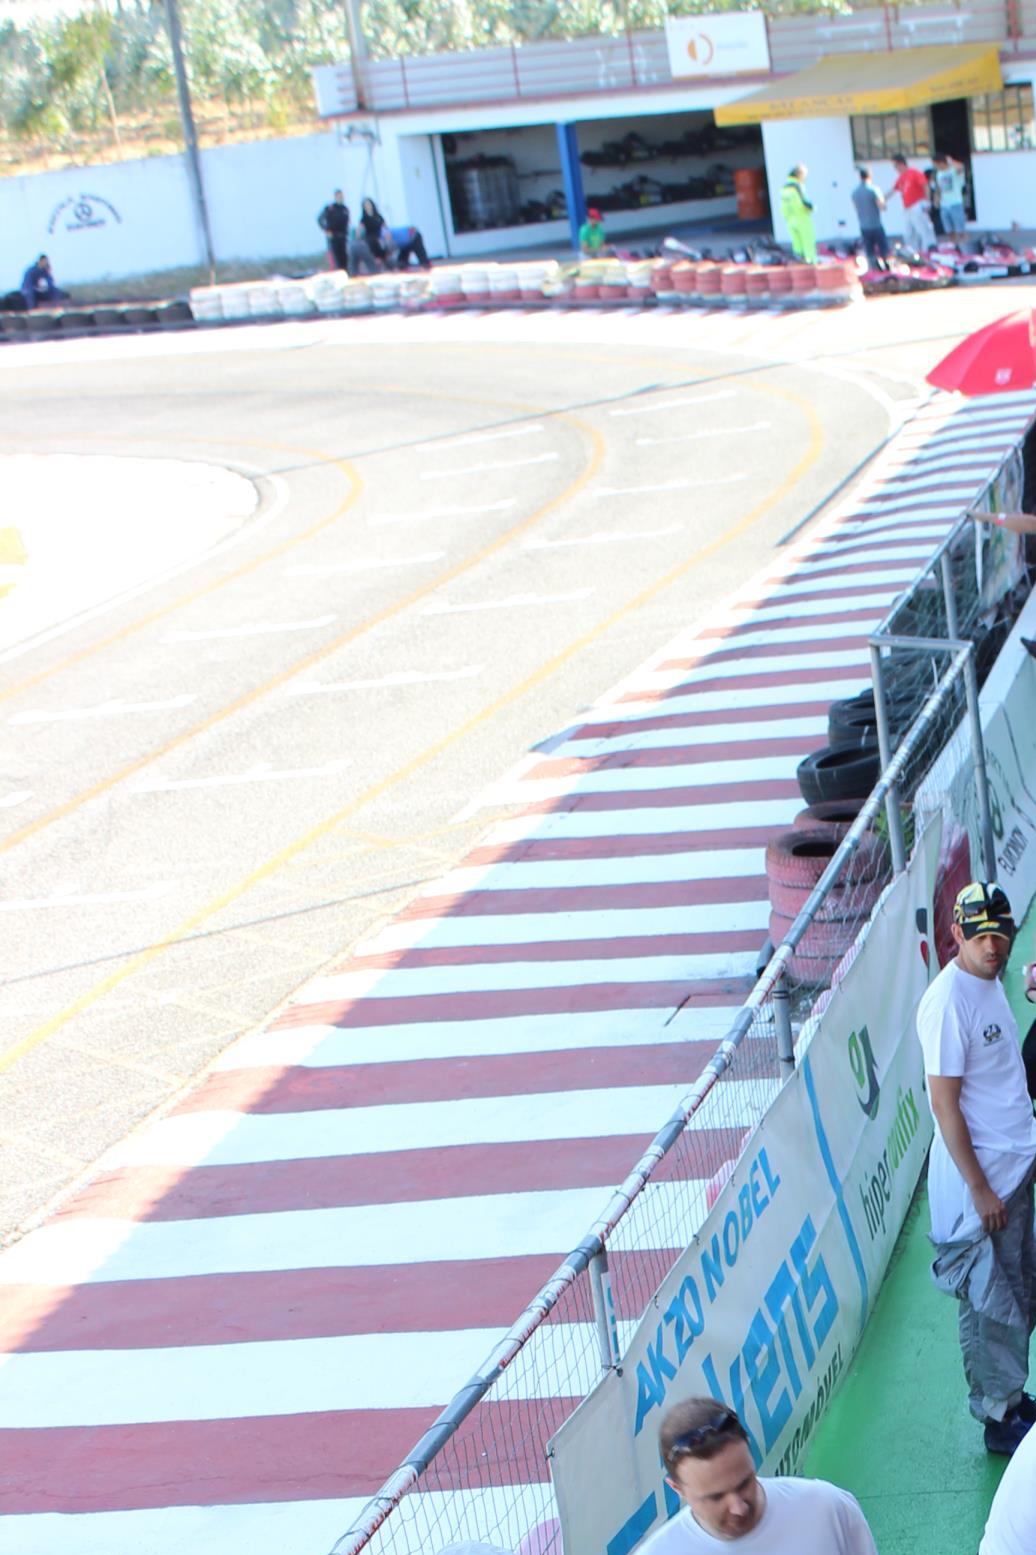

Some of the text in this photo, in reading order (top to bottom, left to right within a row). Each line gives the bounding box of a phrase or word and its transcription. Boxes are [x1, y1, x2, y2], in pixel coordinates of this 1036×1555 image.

[634, 1146, 781, 1438] AKZO NOBEL
[774, 1343, 844, 1478] UTOMÓVEL
